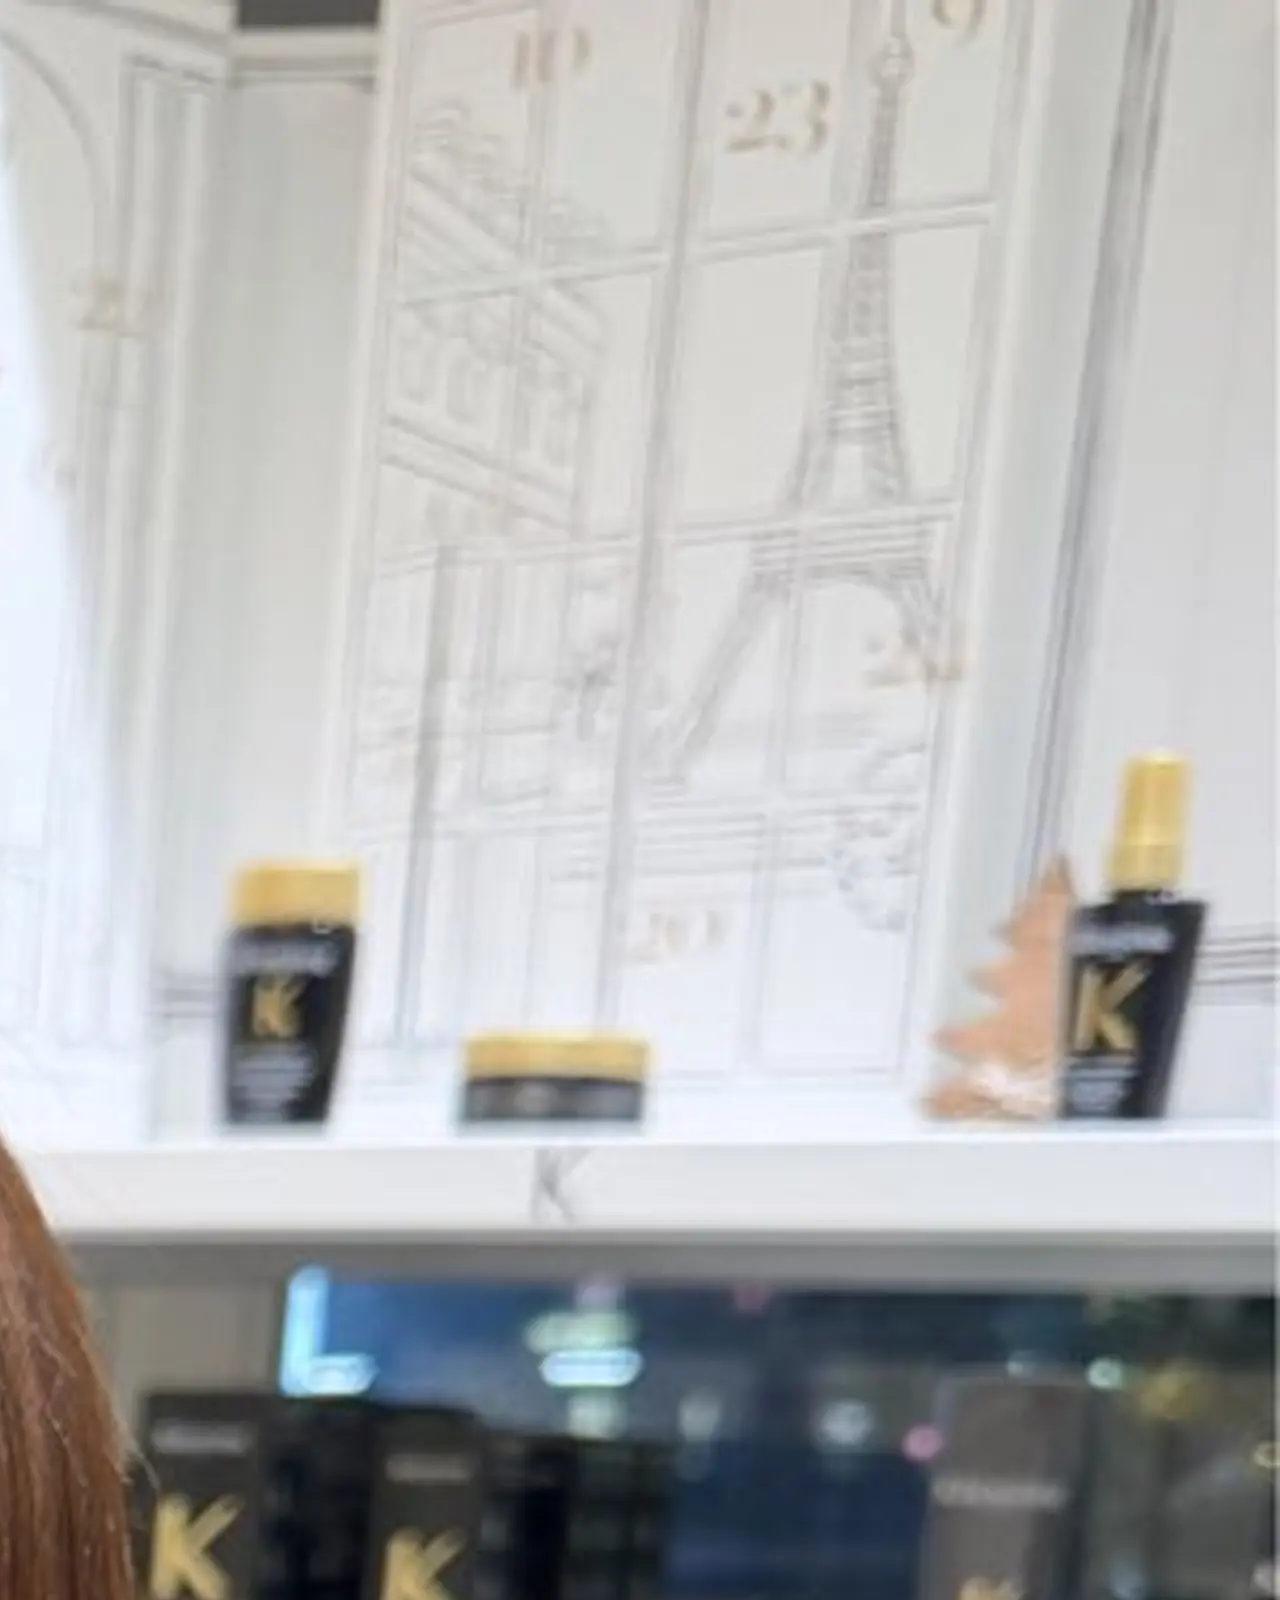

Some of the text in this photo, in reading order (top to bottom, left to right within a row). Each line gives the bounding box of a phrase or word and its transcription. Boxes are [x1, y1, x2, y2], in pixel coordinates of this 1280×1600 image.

[725, 80, 831, 154] 23
[1073, 963, 1150, 1051] K
[530, 1148, 591, 1226] K
